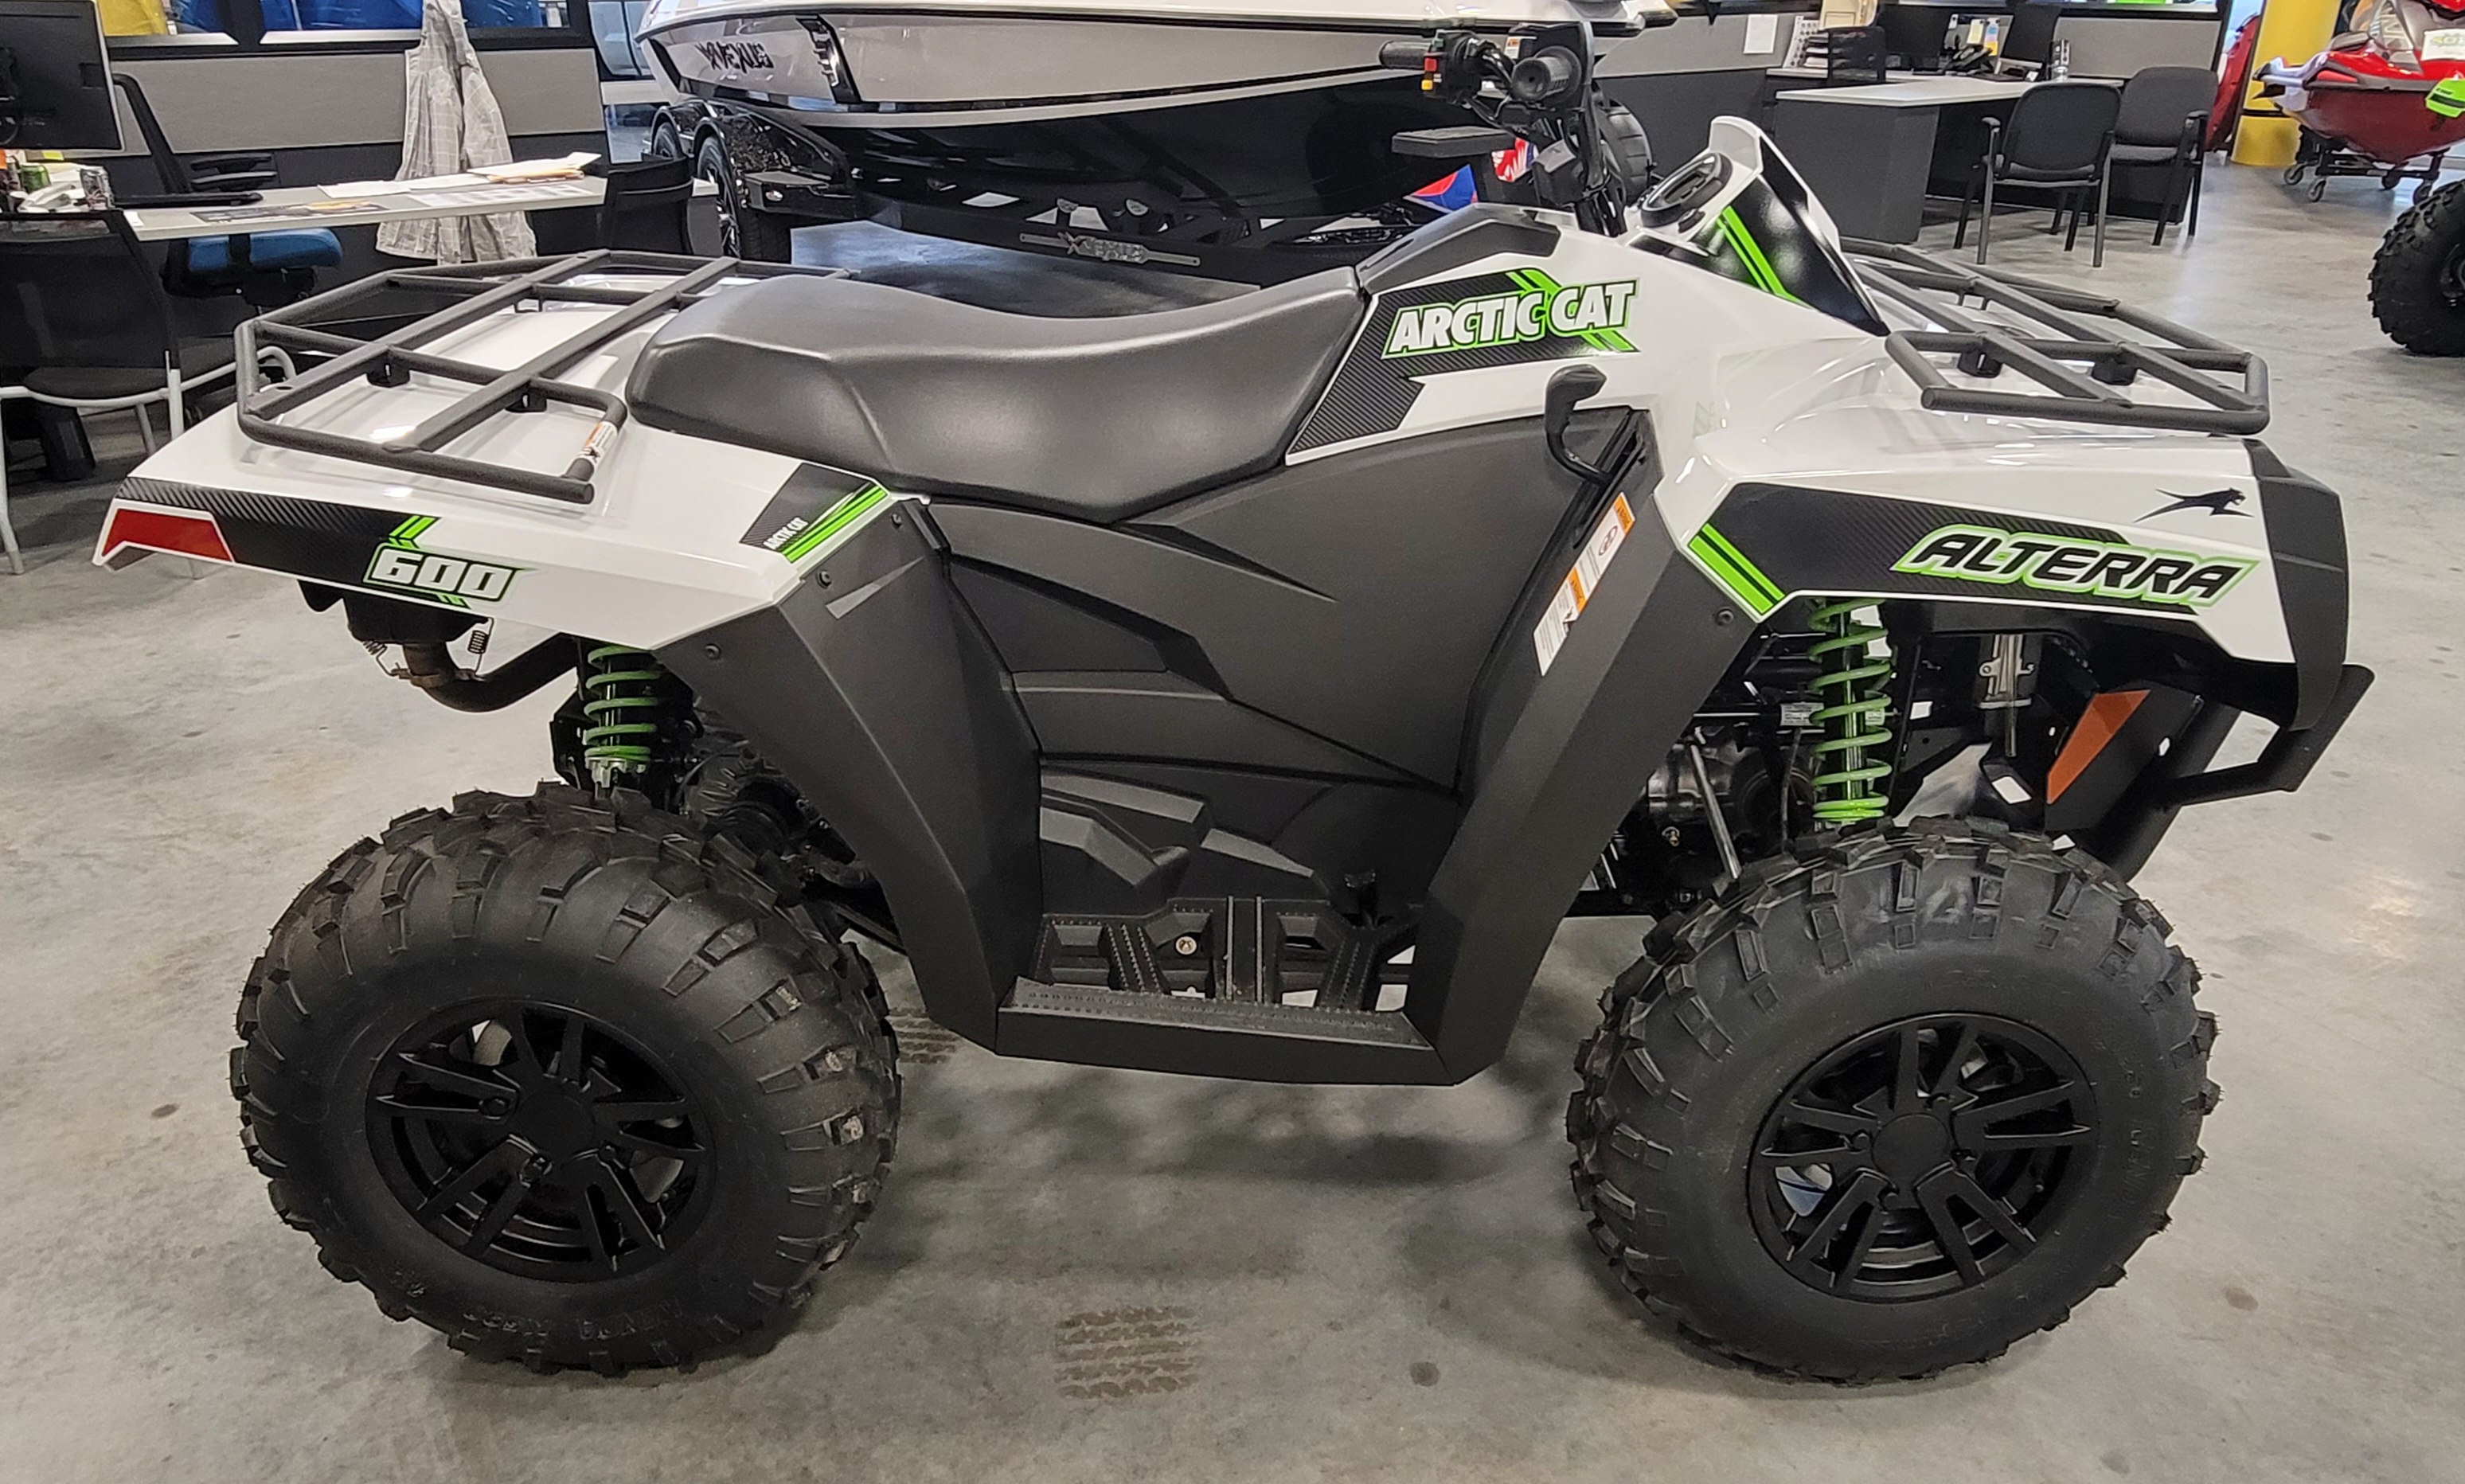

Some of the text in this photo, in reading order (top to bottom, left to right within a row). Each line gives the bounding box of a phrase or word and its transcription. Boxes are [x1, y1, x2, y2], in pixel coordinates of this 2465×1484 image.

[1388, 282, 1635, 353] ARCTIC CAT
[763, 517, 809, 550] ARCTIC CAT
[370, 548, 514, 599] 600
[1910, 533, 2242, 599] ALTERRA
